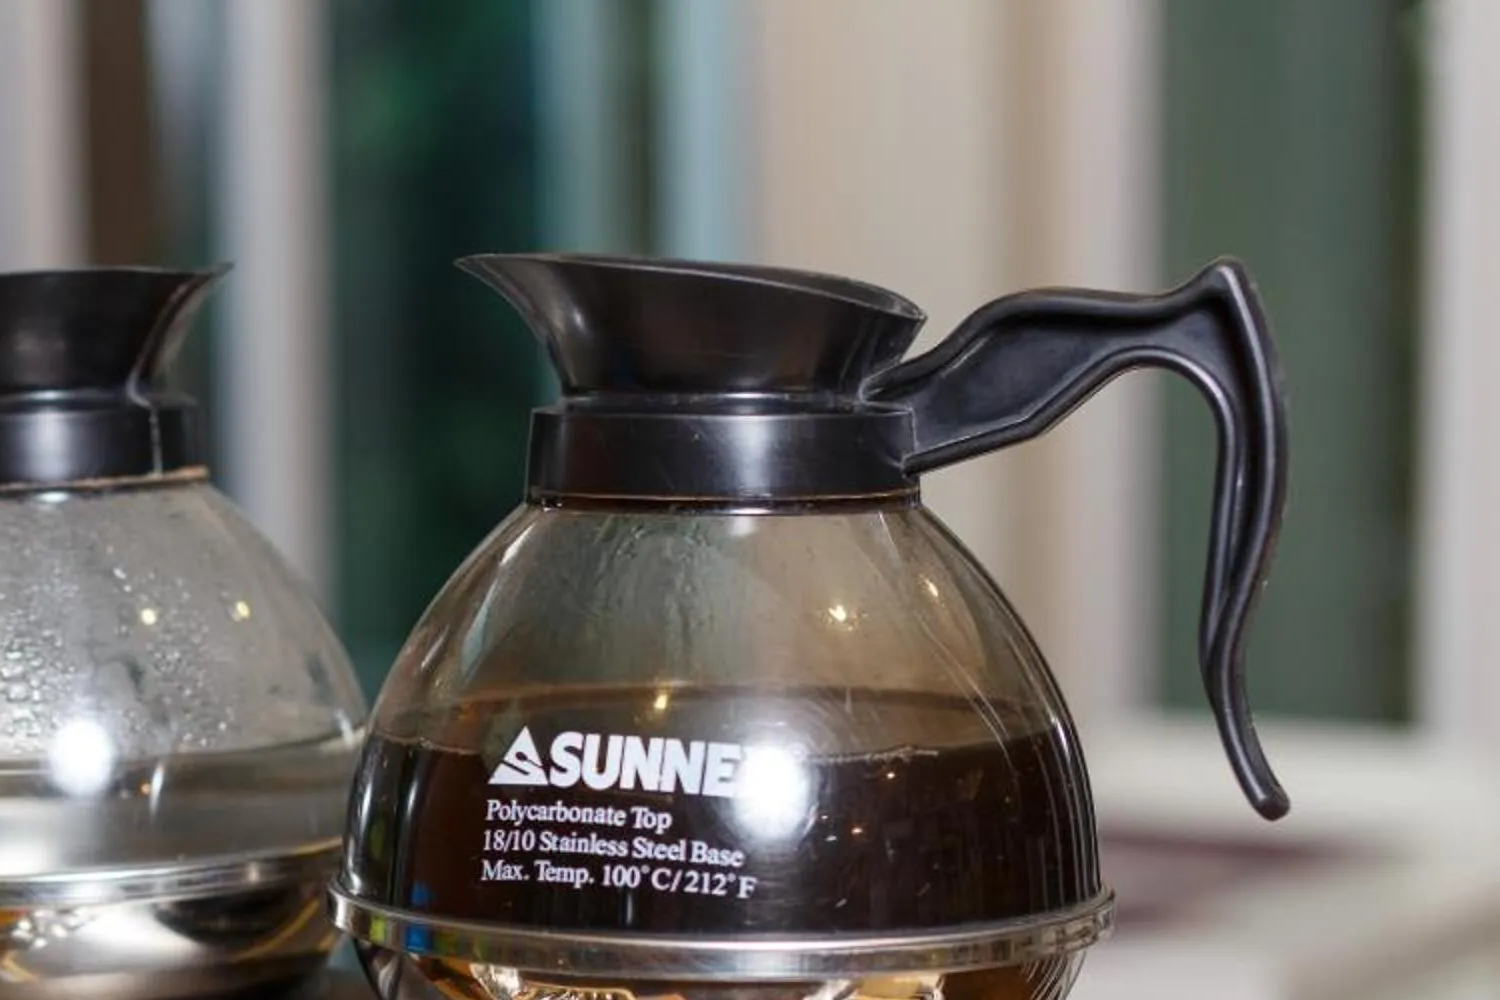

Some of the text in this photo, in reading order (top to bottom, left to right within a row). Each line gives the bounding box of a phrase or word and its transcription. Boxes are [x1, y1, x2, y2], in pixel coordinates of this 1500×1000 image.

[550, 731, 758, 800] SUNNE
[485, 799, 673, 835] Polycarbonate Top
[483, 829, 745, 868] 18/10 Stainless Steel Base
[481, 859, 530, 881] Max.
[533, 859, 595, 889] Temp.
